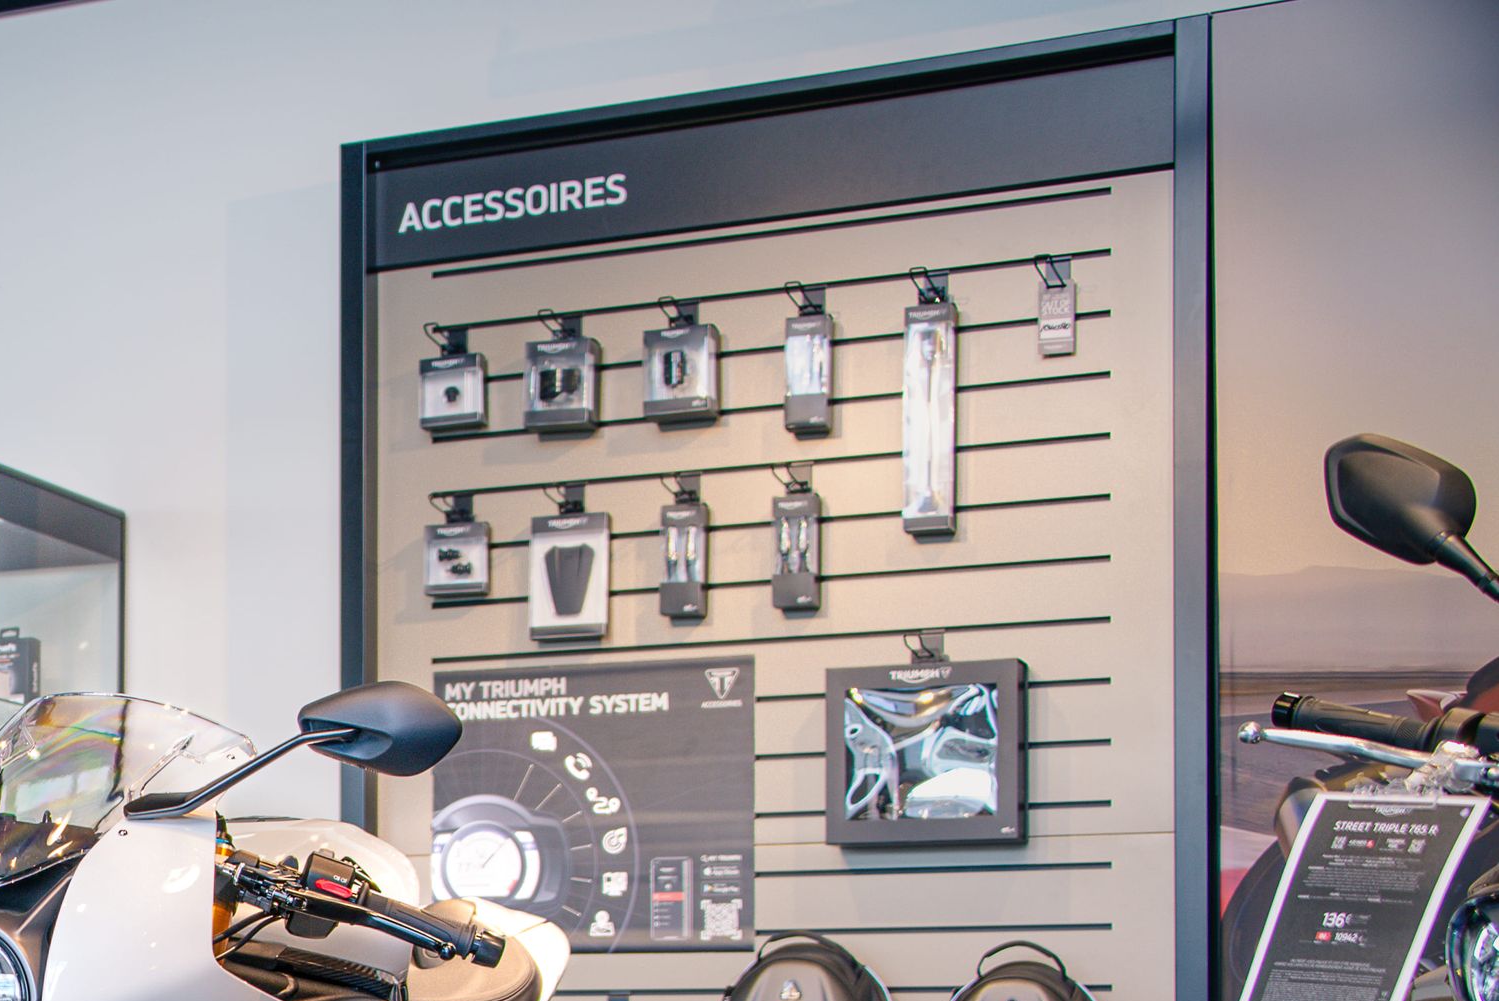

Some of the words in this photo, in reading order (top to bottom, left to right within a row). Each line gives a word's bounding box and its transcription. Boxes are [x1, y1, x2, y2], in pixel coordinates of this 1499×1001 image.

[398, 173, 628, 234] ACCESSOIRES
[889, 669, 940, 684] TRIUMPH
[444, 682, 474, 702] MY
[479, 677, 568, 700] TRIUMPH
[589, 692, 670, 715] SYSTEM
[1333, 820, 1373, 832] STREET
[1373, 822, 1409, 833] TRIPLE
